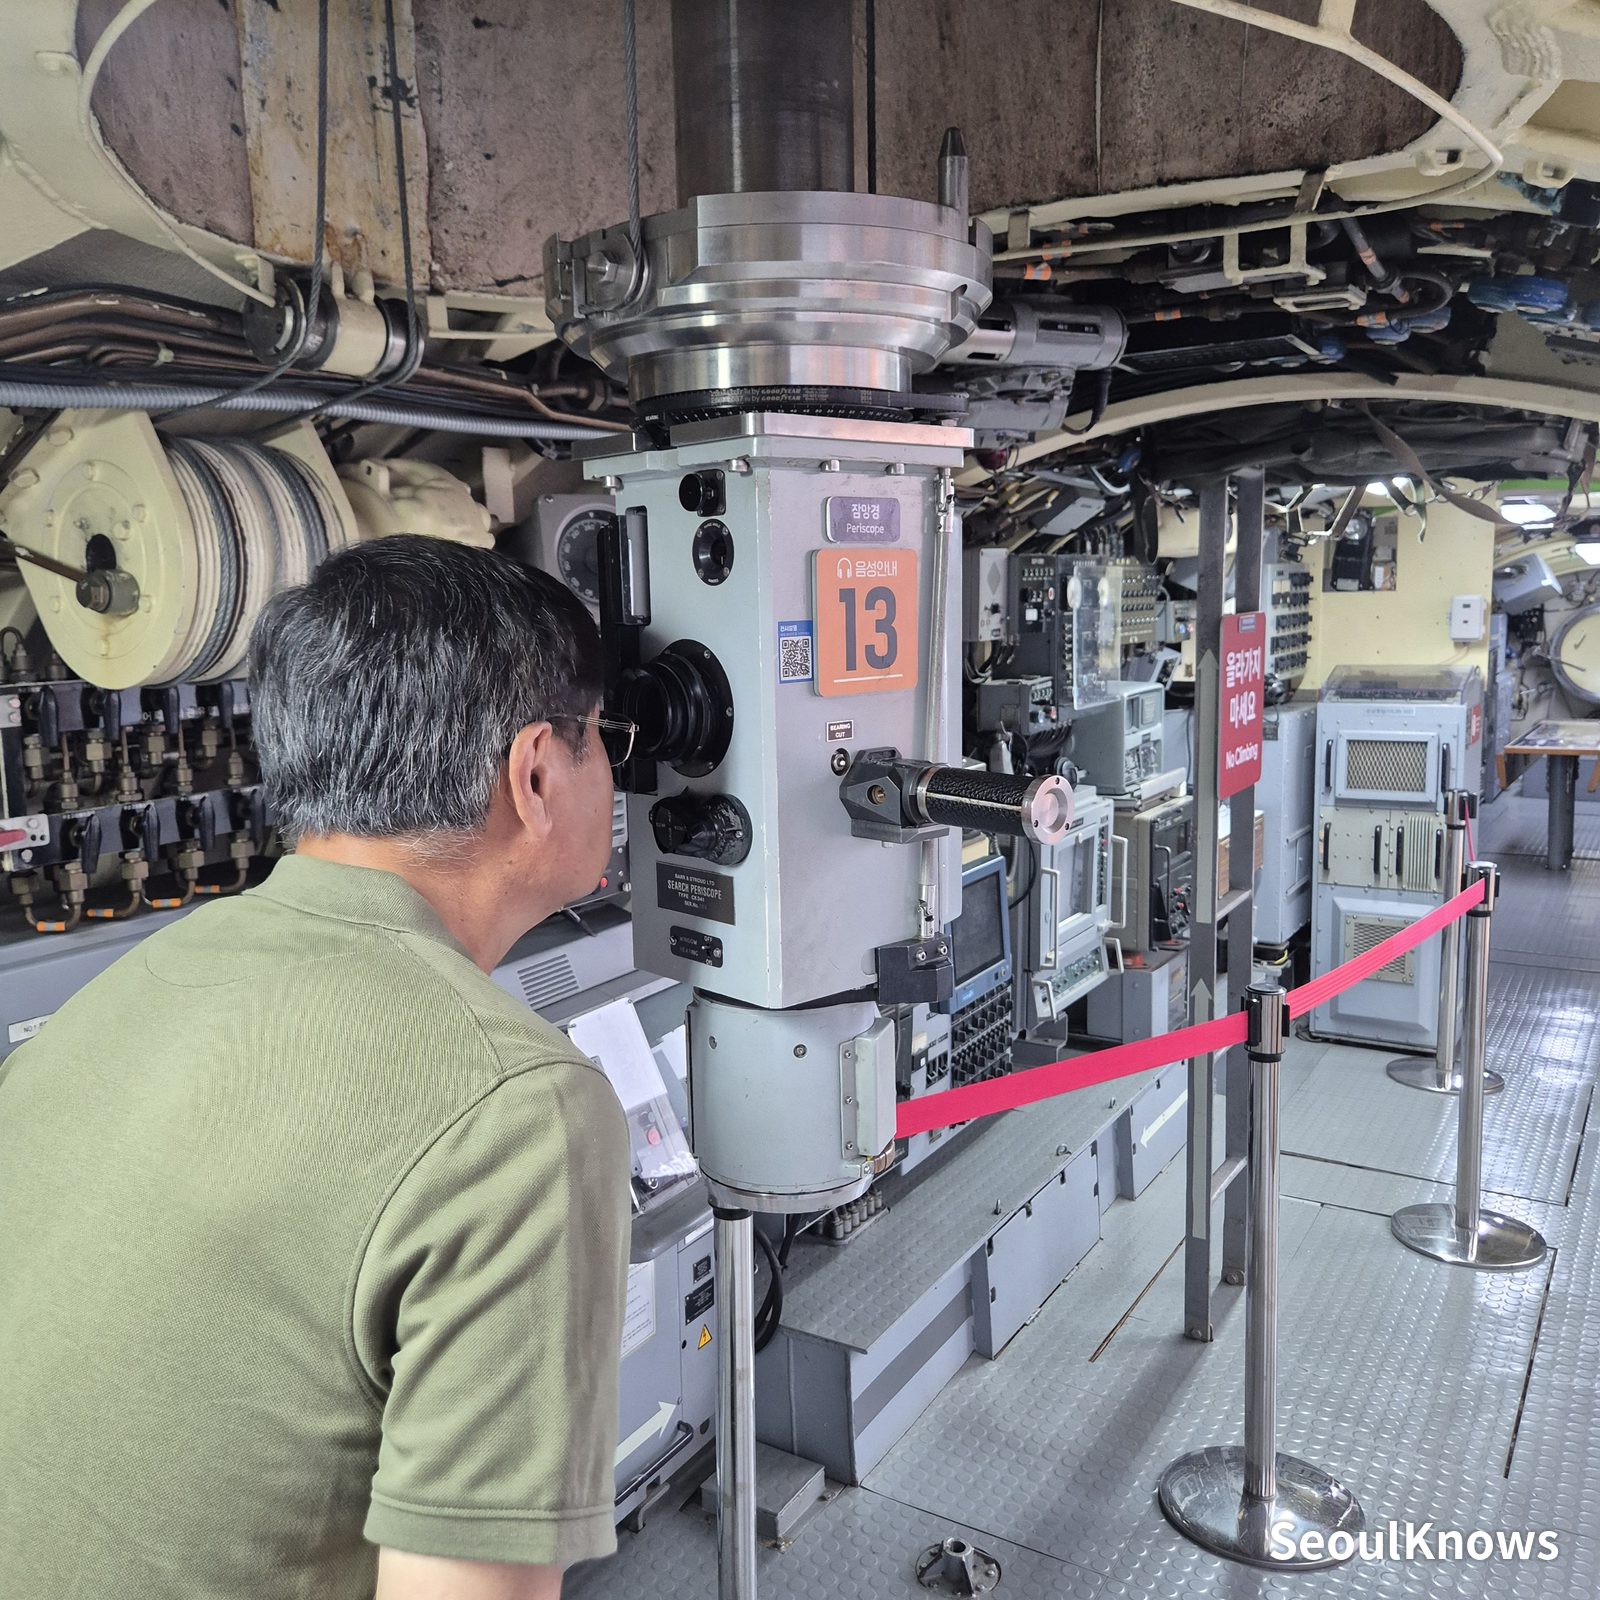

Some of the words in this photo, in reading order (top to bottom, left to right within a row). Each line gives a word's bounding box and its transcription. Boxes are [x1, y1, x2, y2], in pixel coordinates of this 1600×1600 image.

[851, 503, 880, 520] 잠망경
[846, 522, 885, 536] Periscope
[855, 560, 898, 578] 음성안내
[839, 586, 898, 672] 13
[1226, 646, 1262, 688] 올라가지
[1229, 691, 1257, 729] 마세요
[830, 723, 851, 731] BEARING
[1225, 750, 1236, 770] No
[1235, 742, 1259, 766] Climbing
[667, 879, 689, 892] SEARCH
[690, 884, 722, 900] PERISCOPE
[690, 876, 706, 885] STROUD
[678, 891, 689, 899] TYPE
